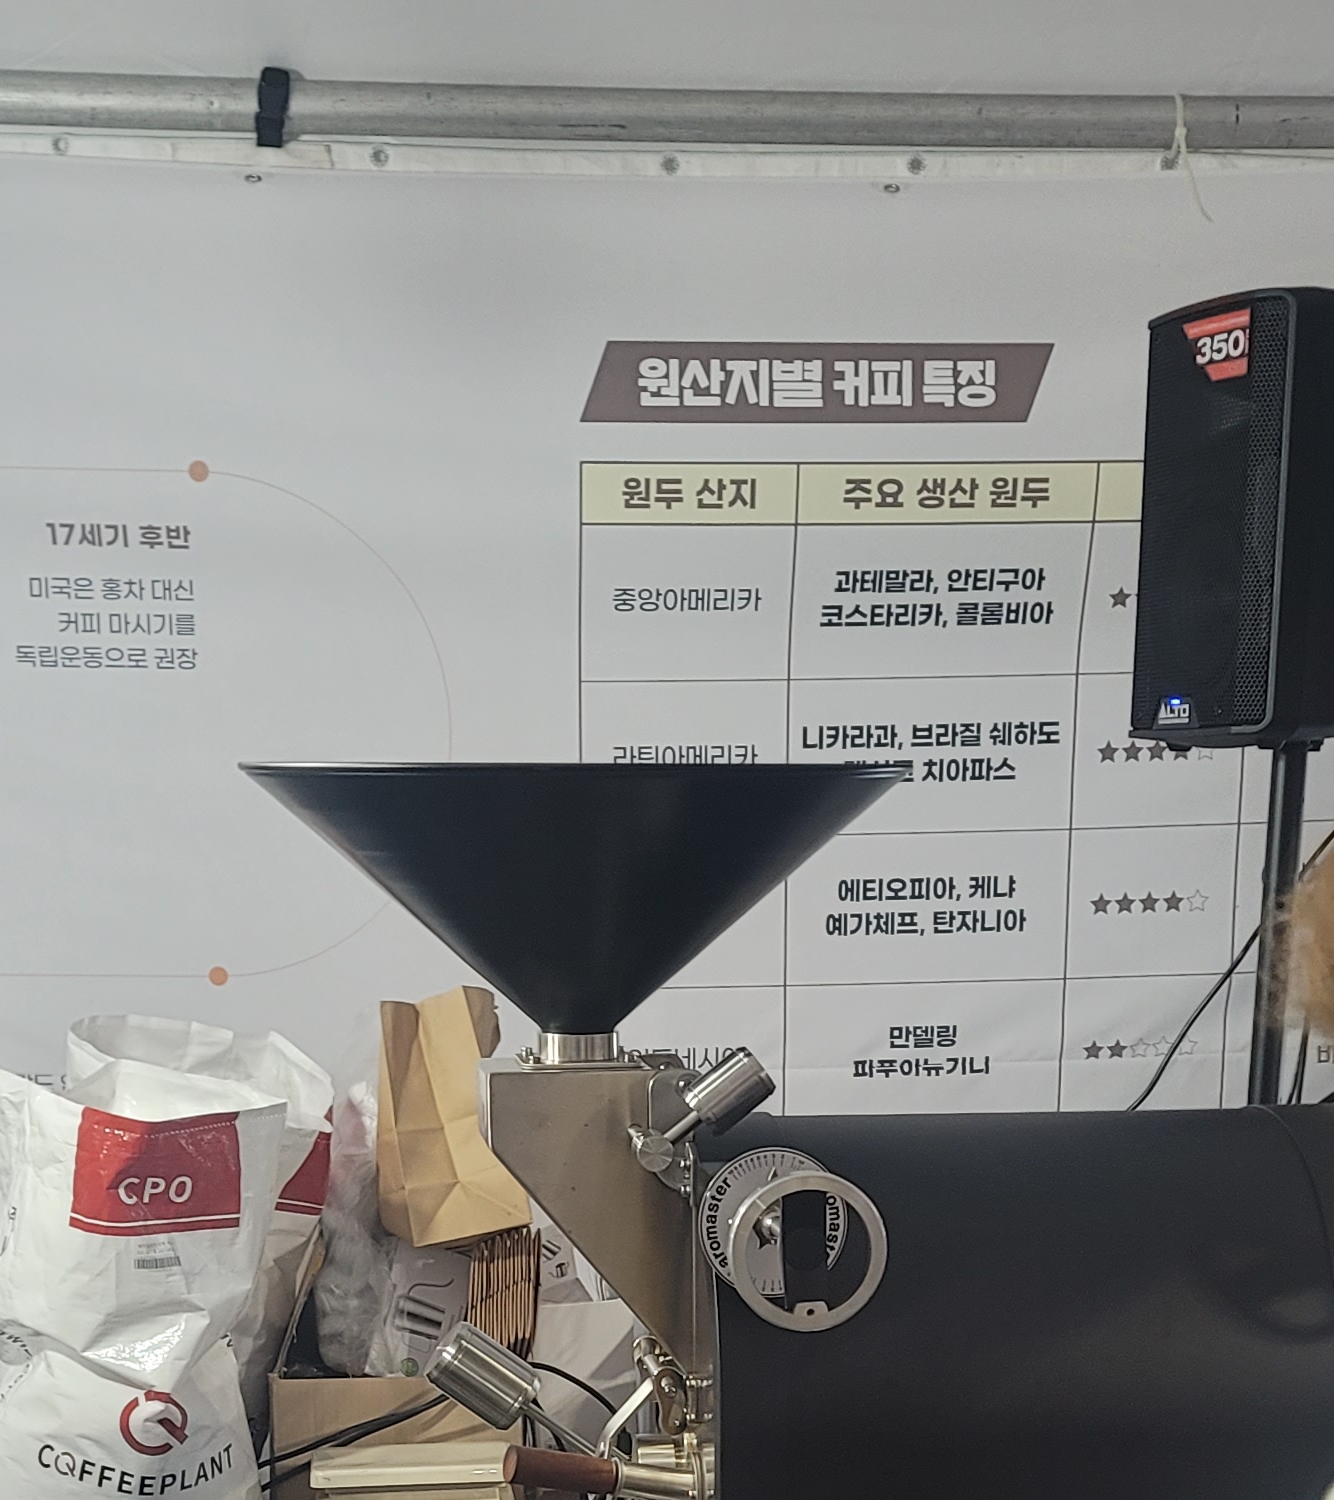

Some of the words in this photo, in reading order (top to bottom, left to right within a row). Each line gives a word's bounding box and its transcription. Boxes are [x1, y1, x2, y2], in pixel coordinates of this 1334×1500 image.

[1195, 328, 1245, 366] 350
[637, 357, 823, 408] 원산지별
[833, 357, 913, 408] 커피
[922, 358, 997, 408] 특징
[621, 476, 685, 510] 원두
[695, 476, 759, 510] 산지
[843, 476, 905, 510] 주요
[916, 475, 980, 510] 생산
[988, 475, 1051, 510] 원두
[46, 522, 130, 549] 17세기
[138, 524, 191, 550] 후반
[28, 576, 95, 600] 미국은
[100, 577, 145, 601] 홍차
[151, 578, 195, 601] 대신
[833, 569, 940, 595] 과테말라,
[946, 566, 1046, 593] 안티구아
[611, 586, 762, 613] 중앙아메리카
[58, 611, 101, 634] 커피
[108, 612, 196, 636] 마시기를
[819, 602, 948, 629] 코스타리카,
[955, 600, 1054, 627] 콜롬비아
[15, 645, 149, 669] 독립운동으로
[153, 647, 198, 670] 권장
[1158, 702, 1189, 718] ALTO
[801, 725, 904, 752] 니카라과,
[910, 721, 983, 748] 브라질
[989, 719, 1060, 746] 쉐하도
[921, 756, 1017, 783] 치아파스
[838, 877, 962, 902] 에티오피아,
[968, 875, 1016, 899] 케냐
[825, 911, 926, 936] 예가체프,
[933, 909, 1027, 935] 탄자니아
[889, 1024, 958, 1050] 만델링
[853, 1056, 991, 1080] 파푸아뉴기니
[118, 1175, 193, 1205] CPO
[705, 1176, 733, 1270] aromaster
